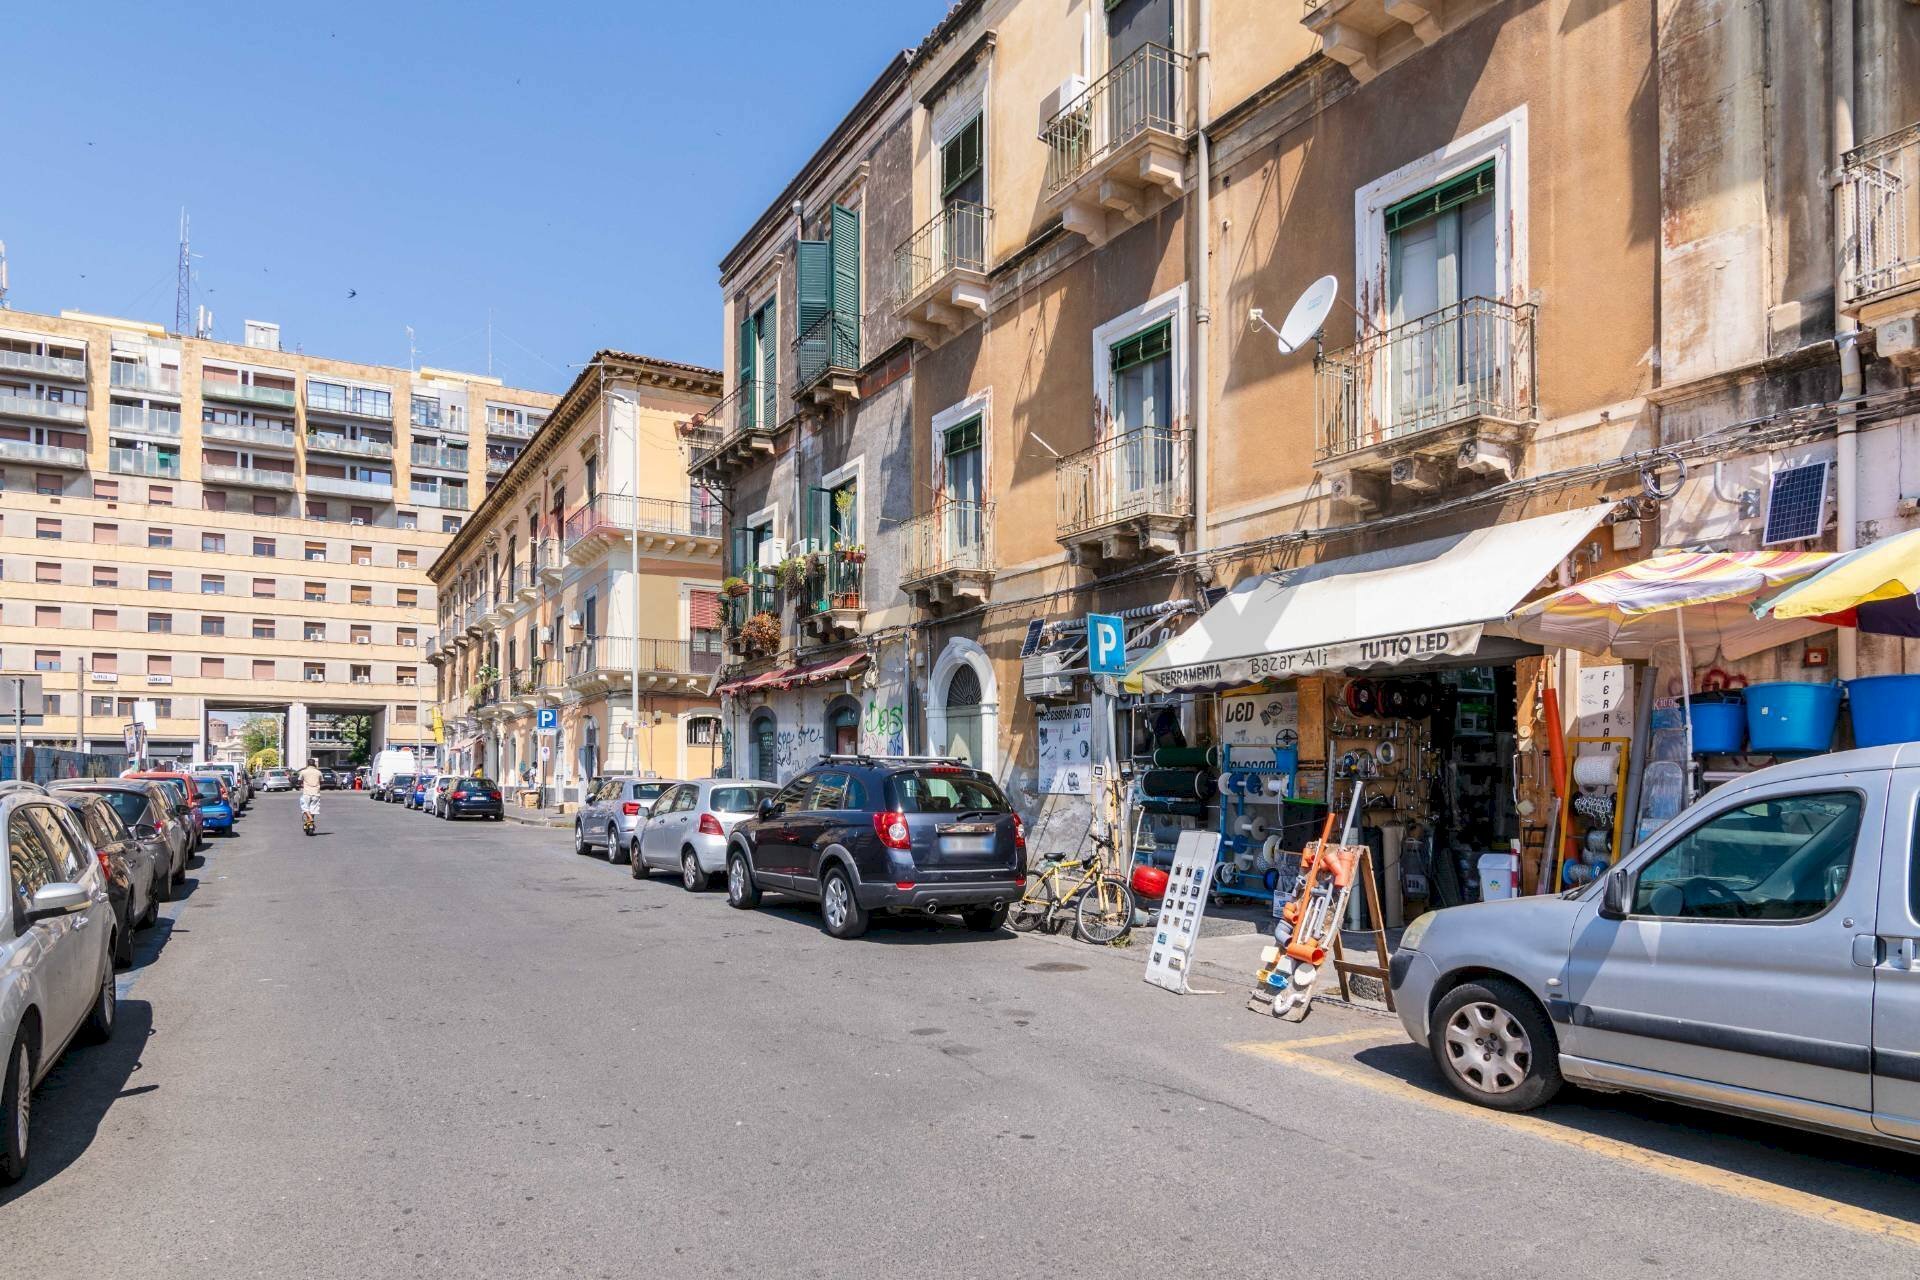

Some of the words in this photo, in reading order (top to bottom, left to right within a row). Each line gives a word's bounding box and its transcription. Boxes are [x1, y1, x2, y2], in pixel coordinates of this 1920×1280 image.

[1097, 623, 1117, 665] P
[1160, 664, 1222, 686] FERRAMENTA
[1248, 654, 1296, 675] Bazar
[1360, 636, 1412, 660] TUTTO
[1416, 632, 1449, 653] LED
[541, 710, 553, 727] P
[1074, 707, 1091, 719] AUTO
[1225, 702, 1255, 723] LED
